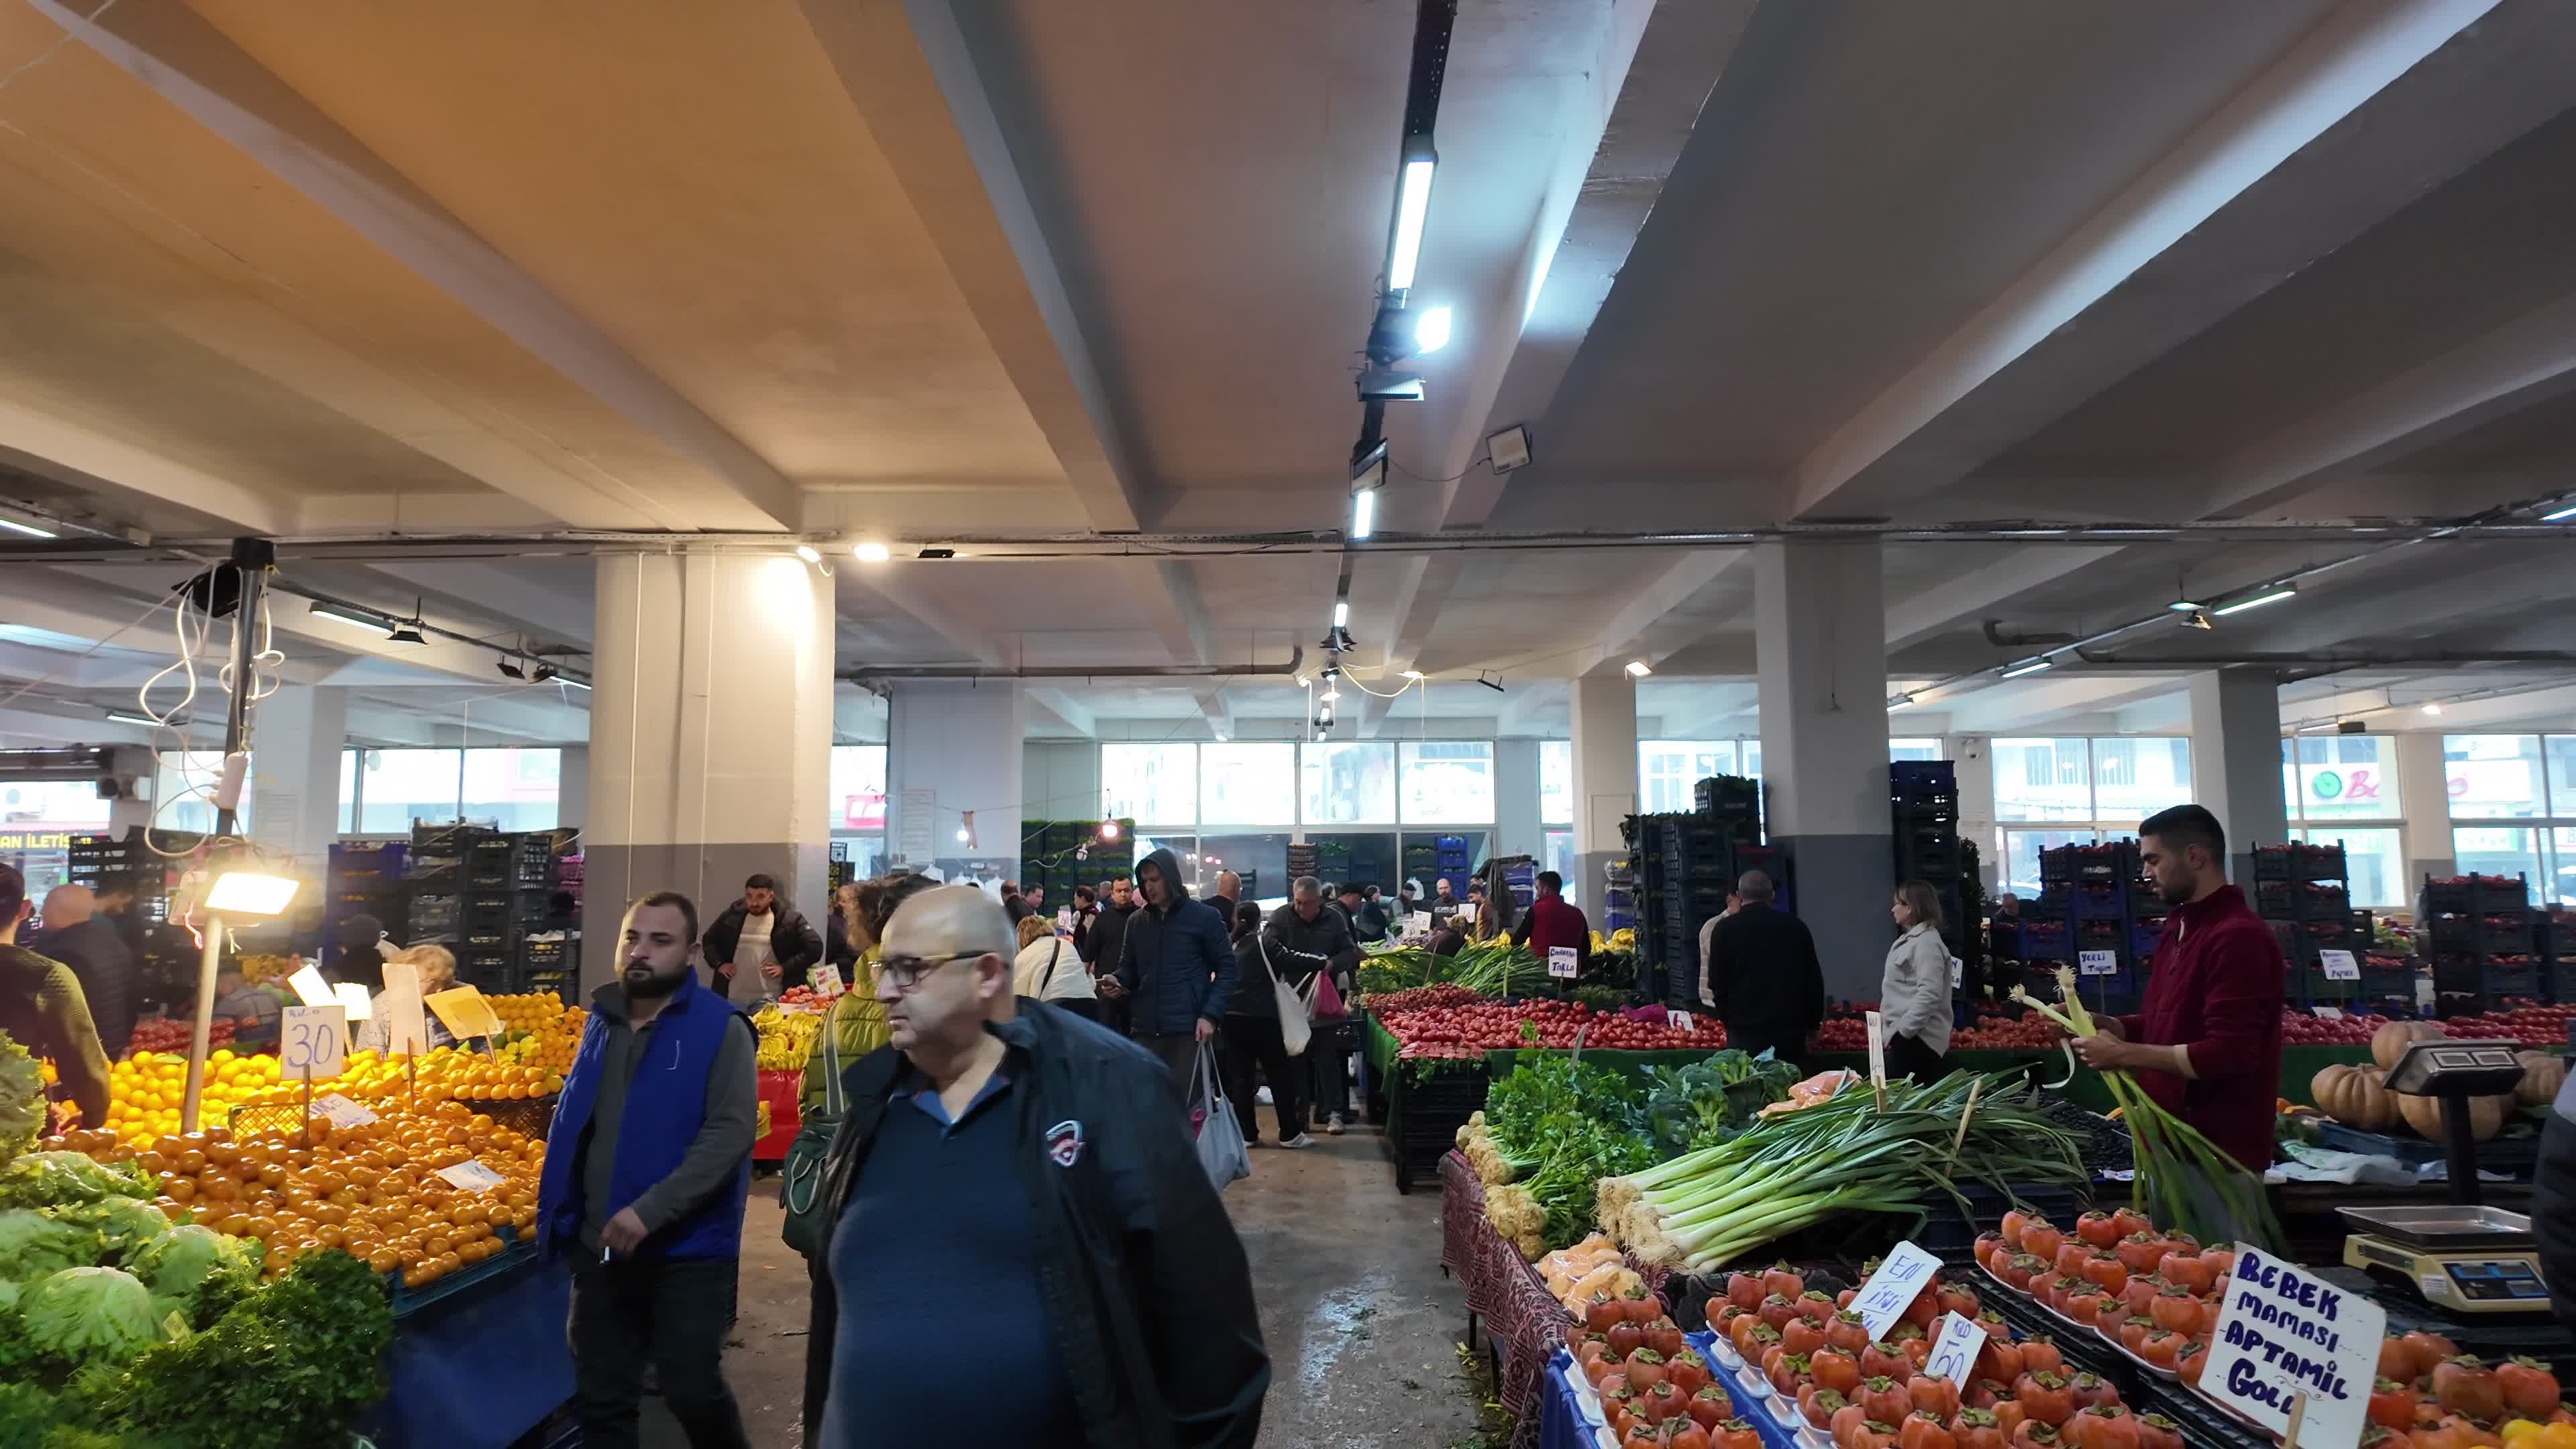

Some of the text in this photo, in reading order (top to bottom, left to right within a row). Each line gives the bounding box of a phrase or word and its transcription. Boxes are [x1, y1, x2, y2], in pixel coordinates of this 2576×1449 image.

[288, 1023, 333, 1068] 30
[2237, 1252, 2341, 1322] BEBEK
[2236, 1291, 2340, 1353] MAMASI
